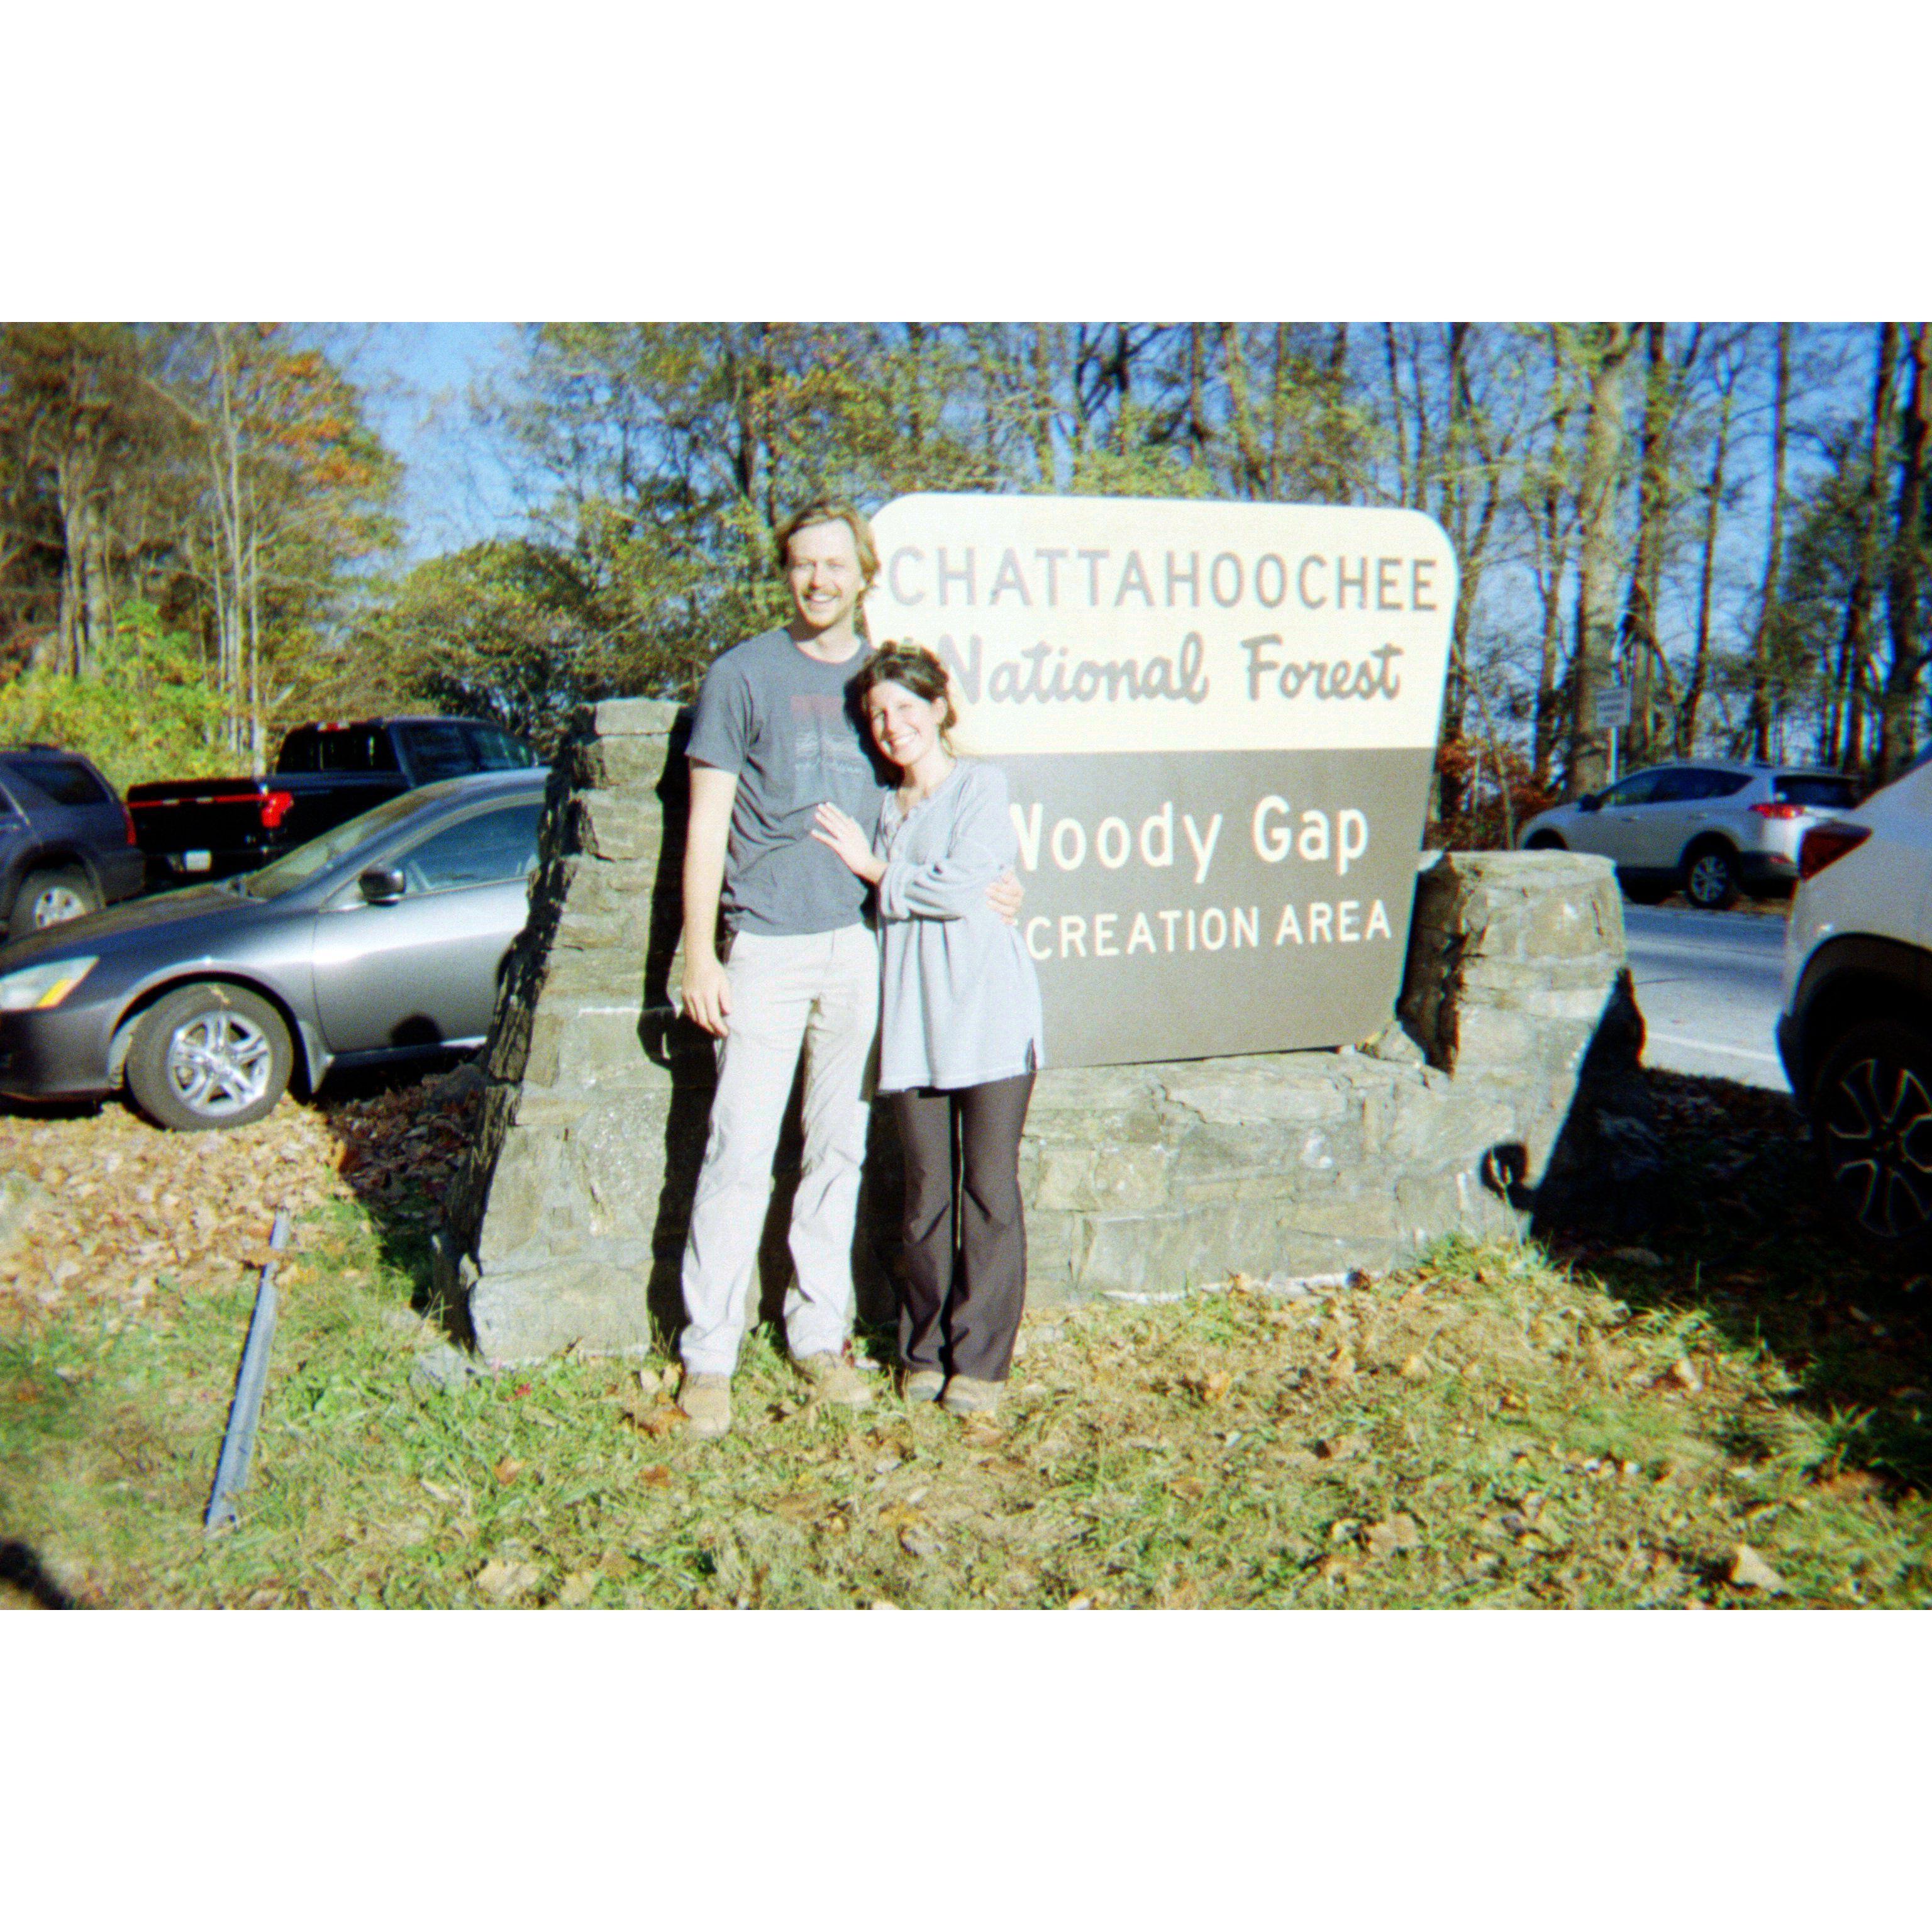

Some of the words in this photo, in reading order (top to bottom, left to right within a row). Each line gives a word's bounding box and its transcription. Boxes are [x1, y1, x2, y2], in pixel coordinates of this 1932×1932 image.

[887, 546, 1438, 611] CHATTAHOOCHEE
[938, 631, 1209, 705] National
[1241, 633, 1405, 702] Forest
[1252, 794, 1369, 875] Gap
[1012, 906, 1260, 960] CREATION
[1275, 899, 1392, 946] AREA
